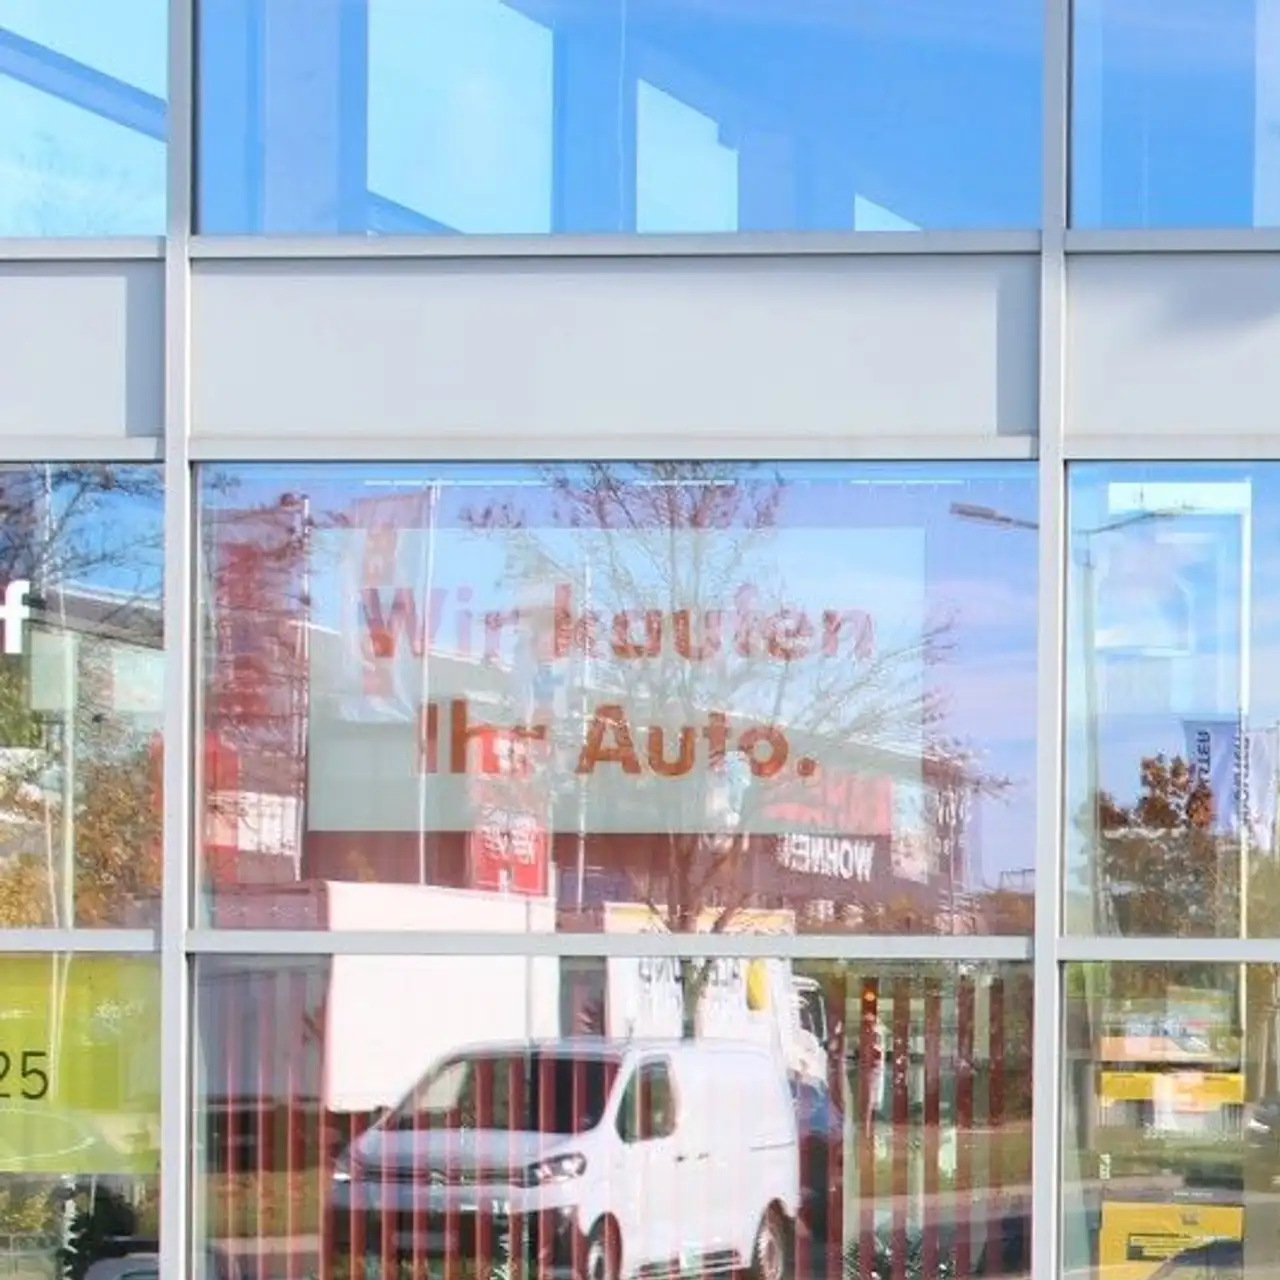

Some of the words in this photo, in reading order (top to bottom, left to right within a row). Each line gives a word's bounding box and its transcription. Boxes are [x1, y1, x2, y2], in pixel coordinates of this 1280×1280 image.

[360, 586, 520, 660] Wir
[554, 582, 877, 660] kaufen
[419, 698, 547, 775] Ihr
[576, 702, 819, 778] Auto.
